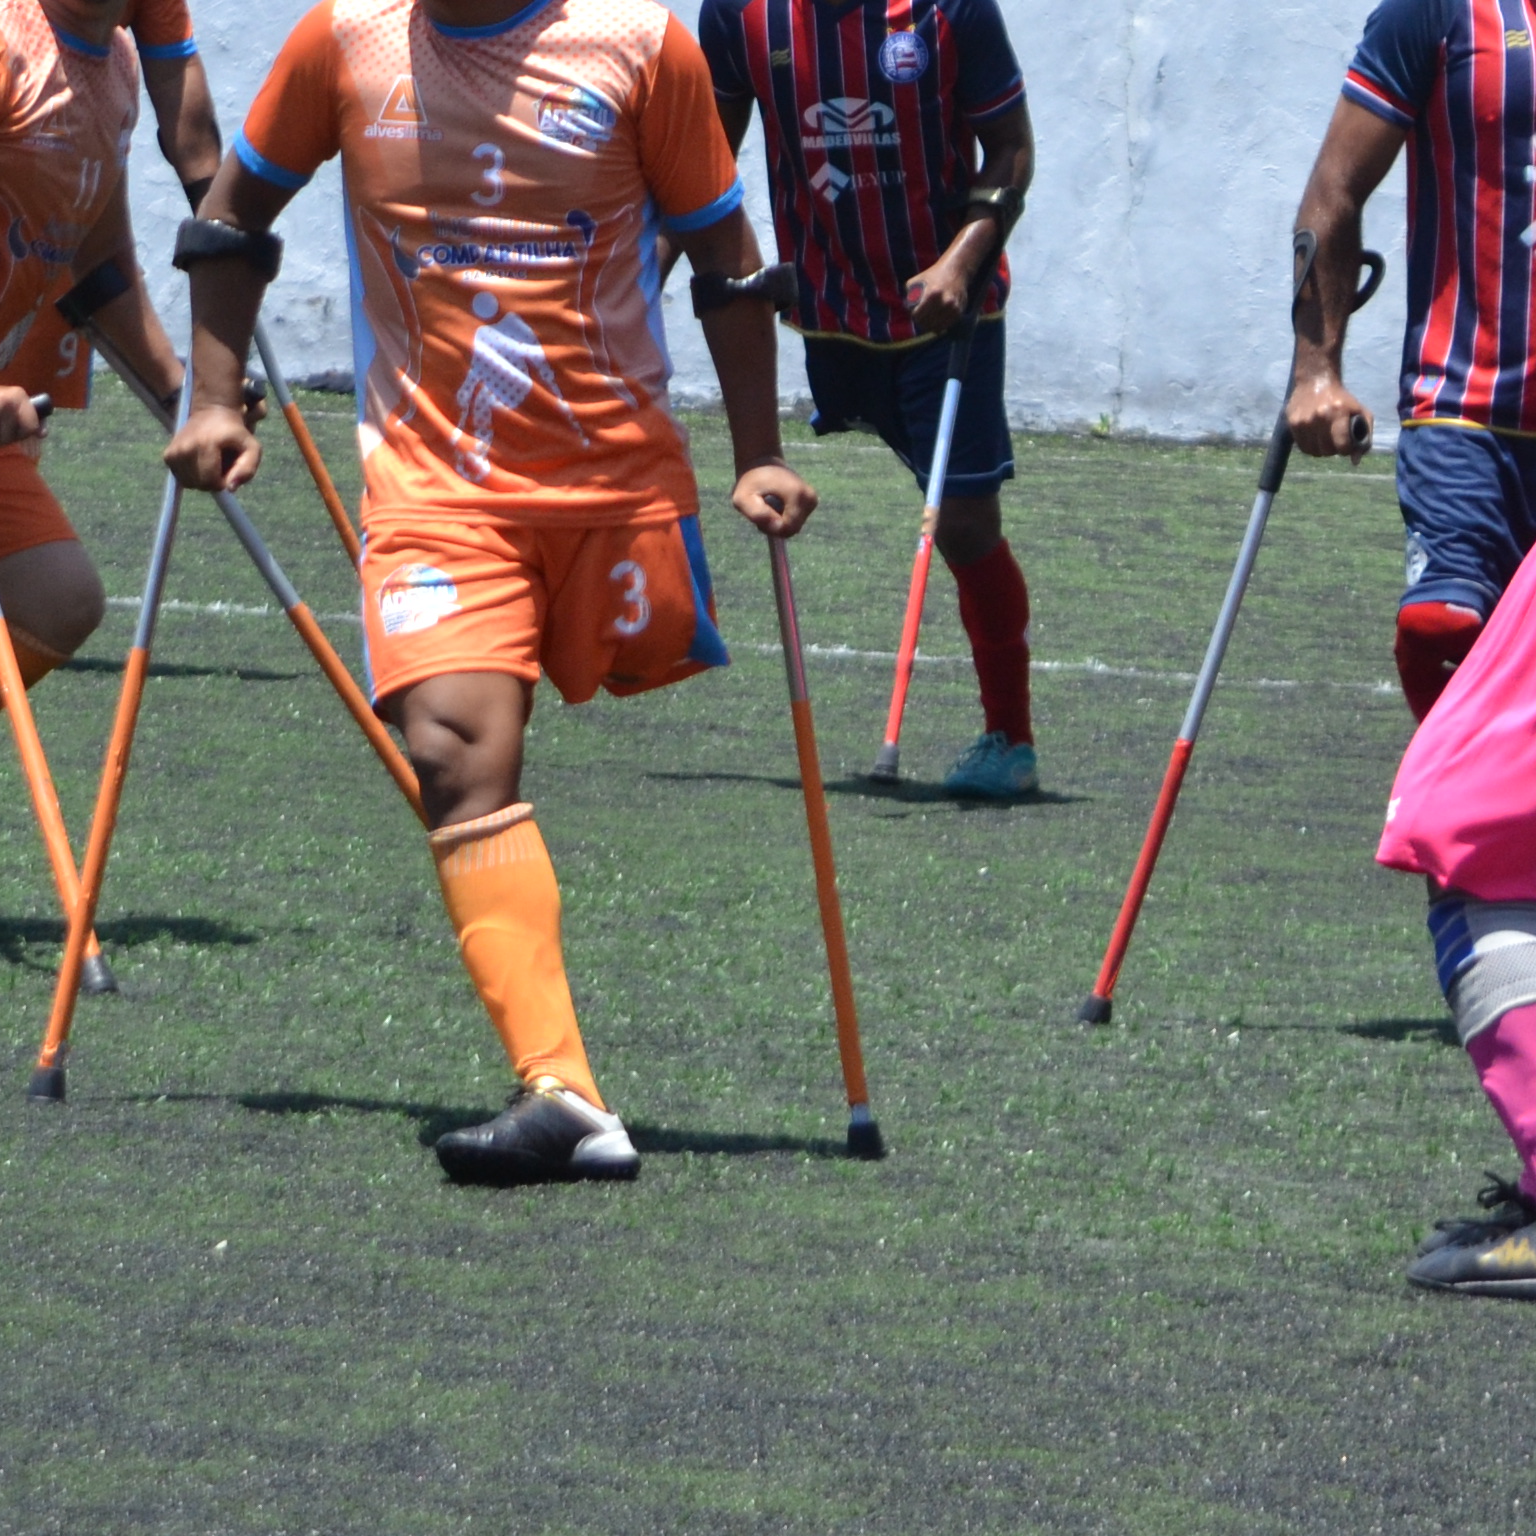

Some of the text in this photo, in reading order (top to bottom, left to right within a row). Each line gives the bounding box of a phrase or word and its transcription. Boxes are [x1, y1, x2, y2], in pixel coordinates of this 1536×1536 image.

[802, 132, 901, 149] MADERVILLAS
[471, 142, 506, 207] 3
[56, 330, 79, 378] 9
[610, 559, 652, 635] 3
